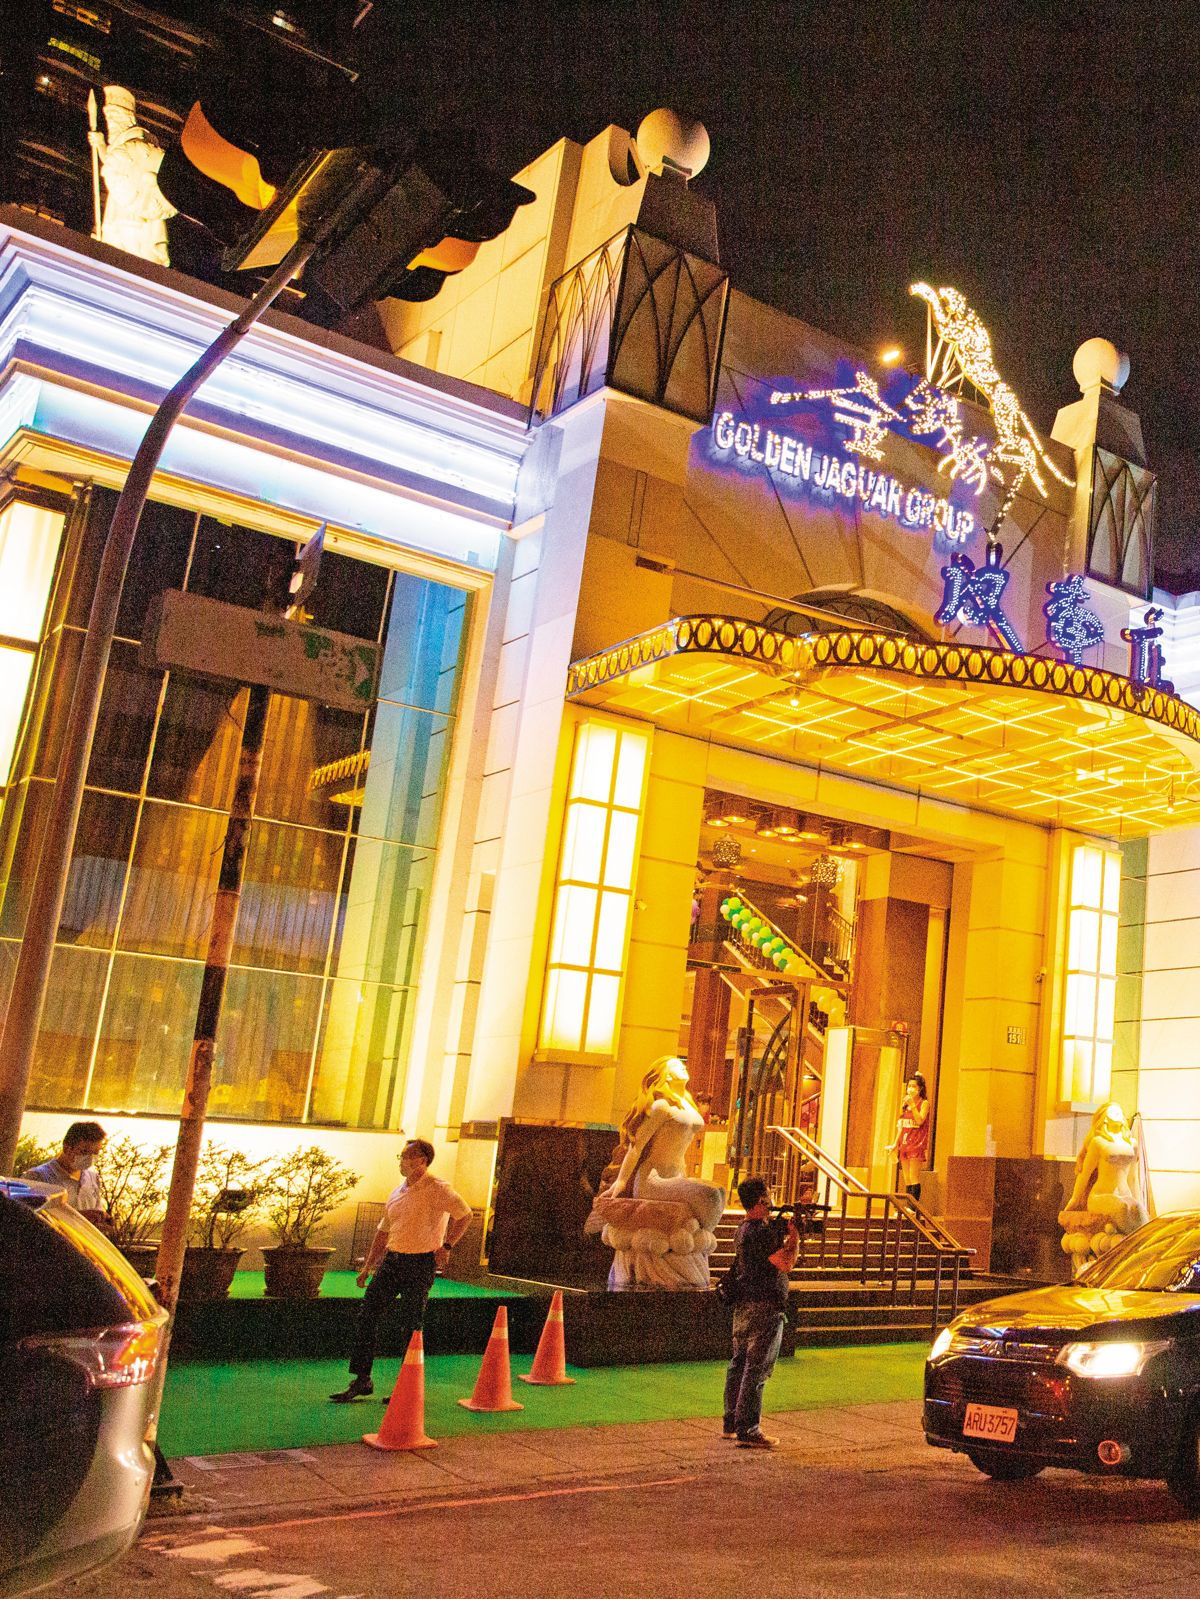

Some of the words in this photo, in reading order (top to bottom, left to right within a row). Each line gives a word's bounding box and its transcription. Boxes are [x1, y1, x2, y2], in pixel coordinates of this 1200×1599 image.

[714, 411, 813, 482] GOLDEN
[815, 454, 904, 518] JAGUAR
[904, 489, 975, 544] GROUP
